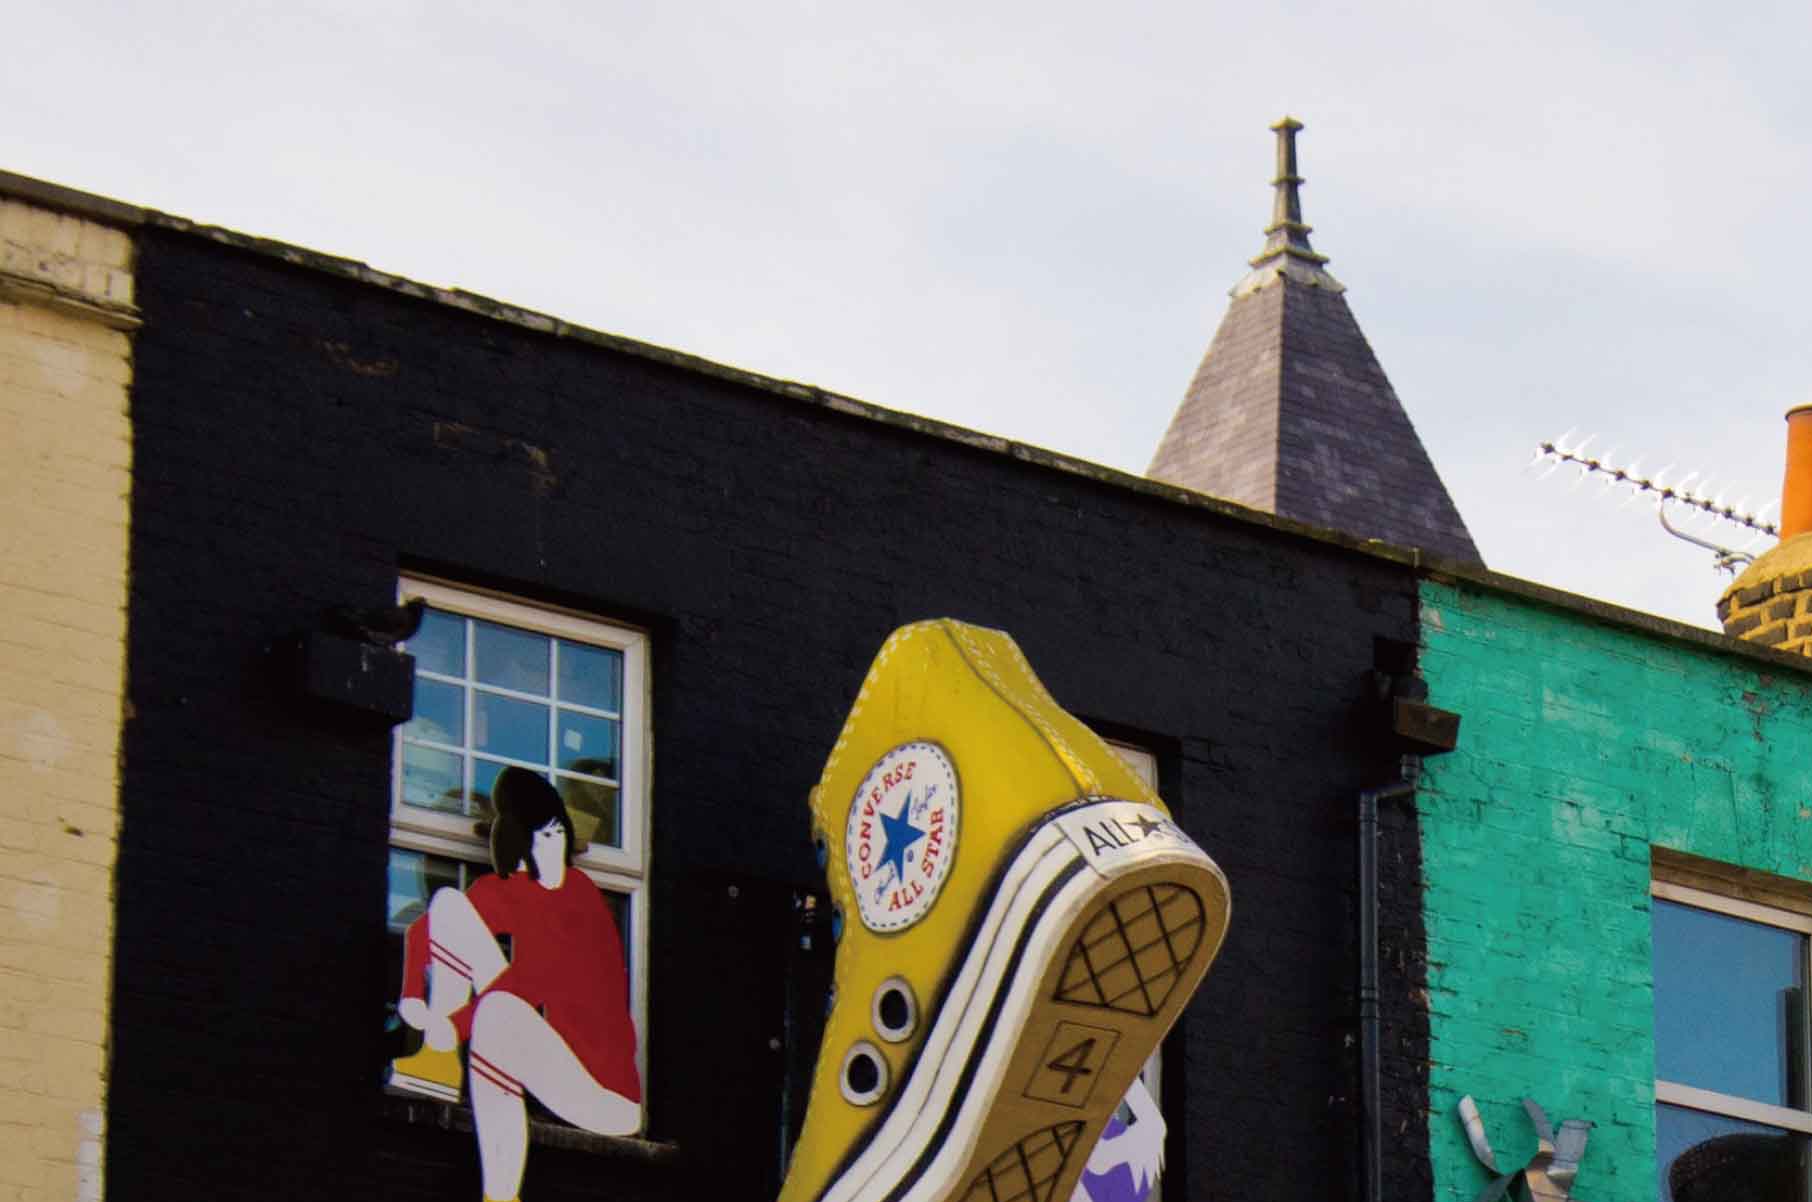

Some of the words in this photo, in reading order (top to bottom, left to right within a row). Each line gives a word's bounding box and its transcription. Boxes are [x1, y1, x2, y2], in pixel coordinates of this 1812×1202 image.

[858, 760, 917, 880] CONVERSE
[887, 878, 925, 913] ALL
[921, 806, 945, 879] STAR
[1083, 818, 1140, 857] ALL
[1046, 1036, 1095, 1094] 4
